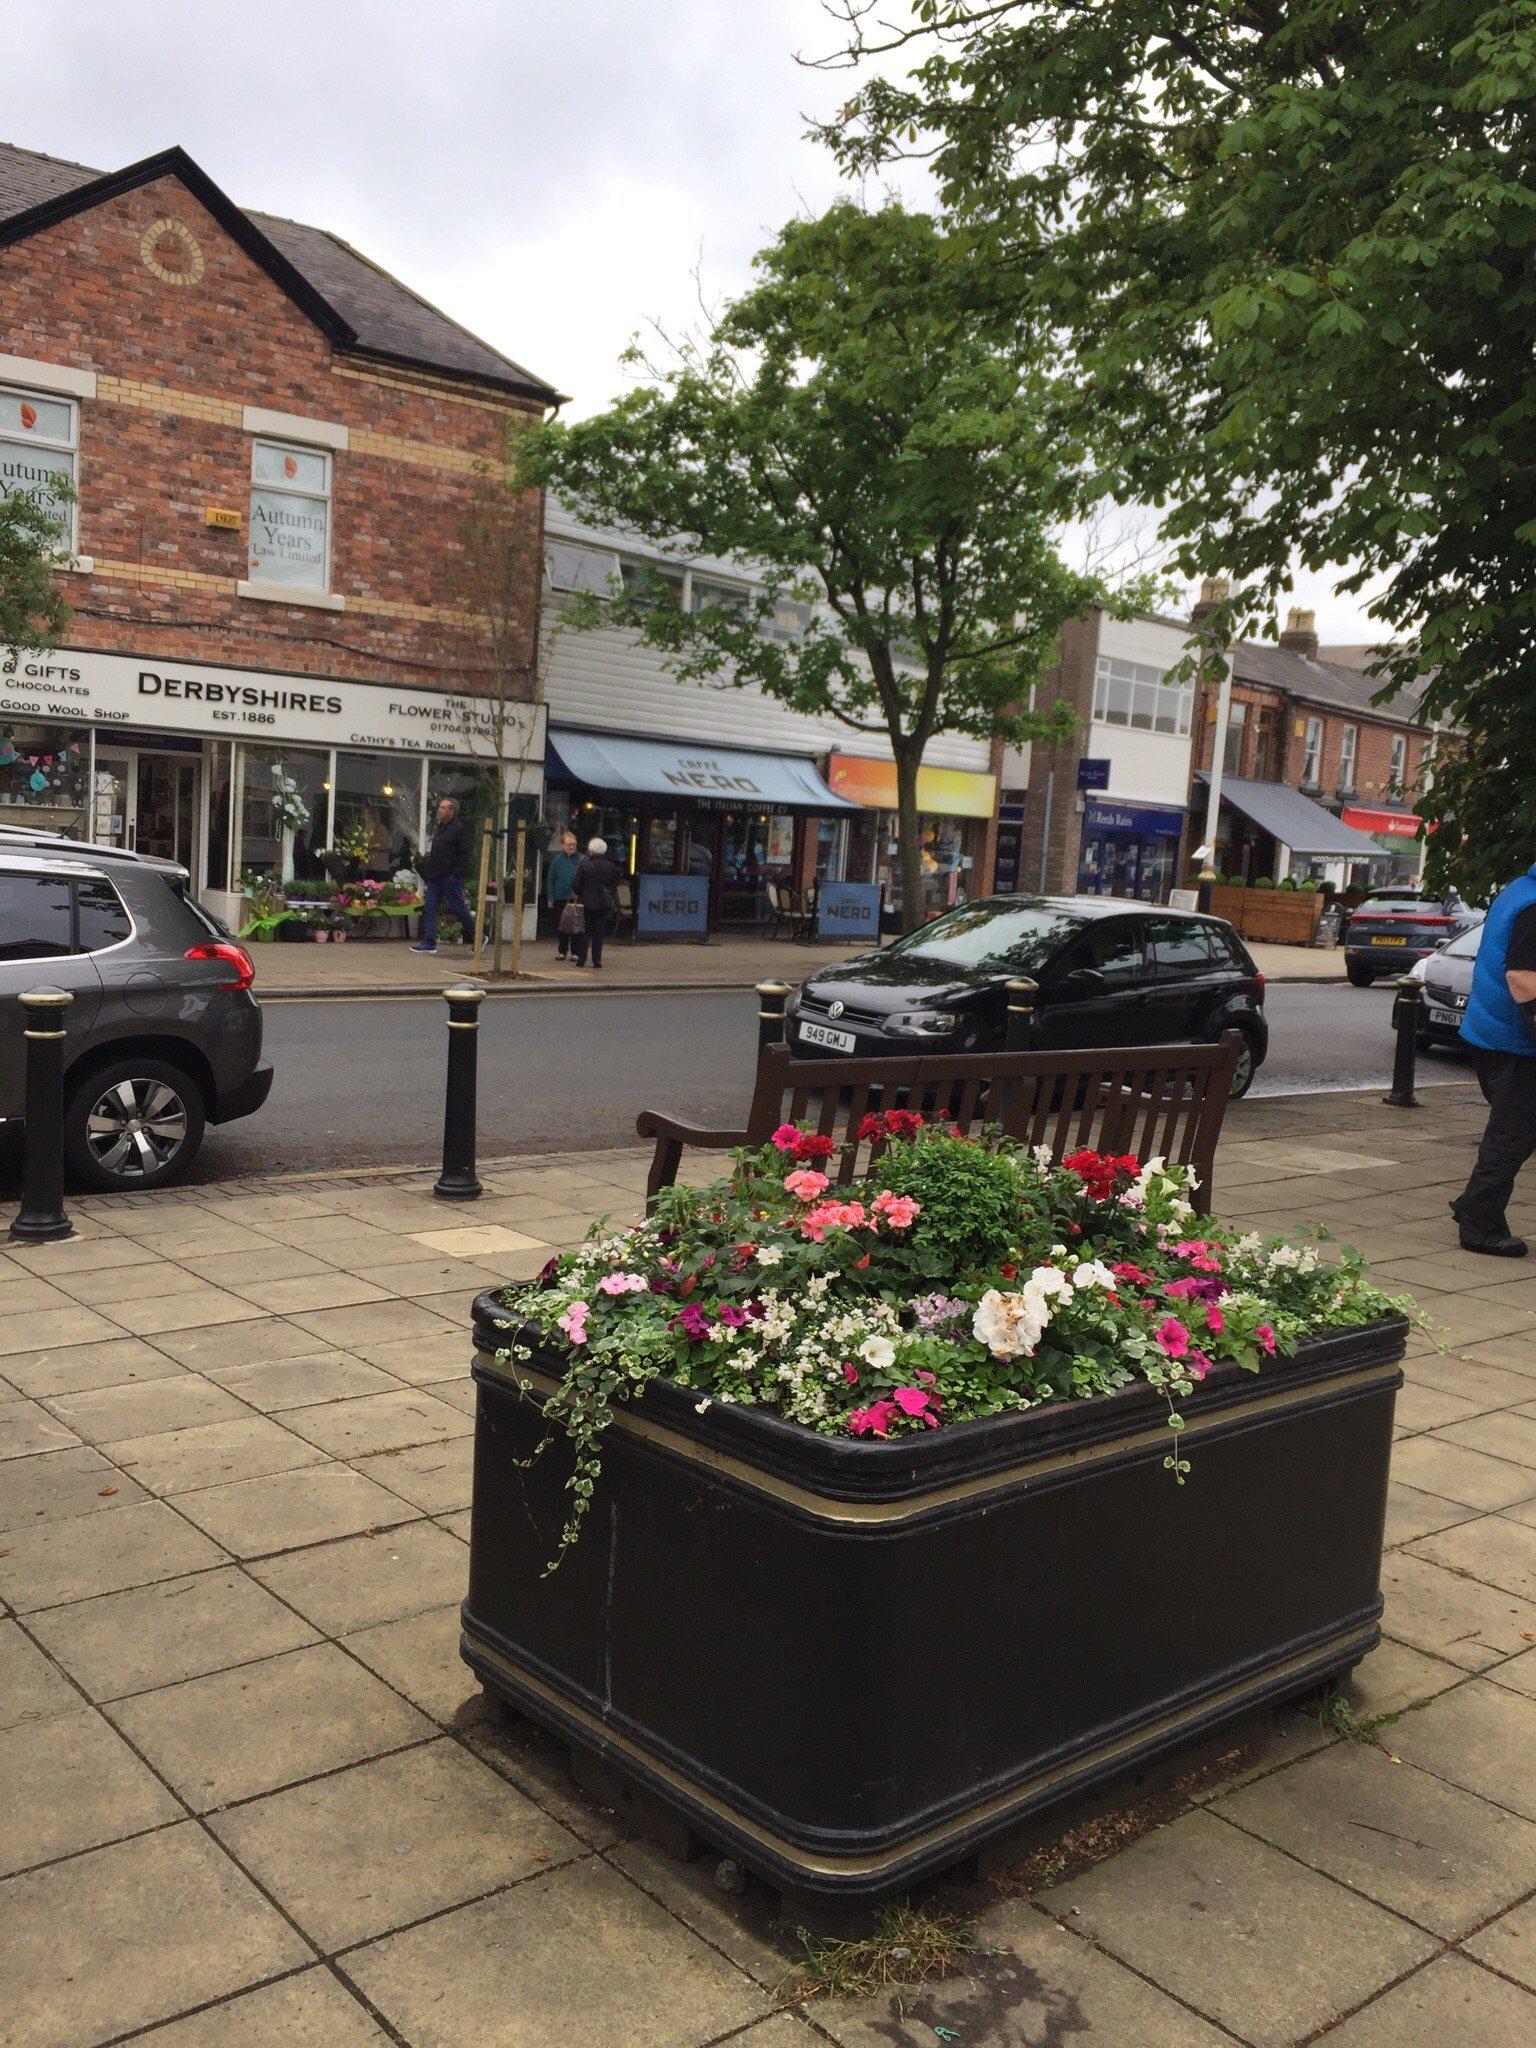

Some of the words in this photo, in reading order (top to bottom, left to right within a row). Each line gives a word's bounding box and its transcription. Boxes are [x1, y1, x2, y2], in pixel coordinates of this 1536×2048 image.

[252, 505, 325, 531] Autumn
[264, 526, 312, 550] Years
[253, 543, 276, 556] Law
[280, 549, 322, 564] Limited
[24, 664, 81, 680] GIFTS
[5, 679, 90, 696] CHOCOLATES
[138, 671, 343, 714] DERBYSHIRES
[1, 700, 41, 712] GOOD
[47, 703, 88, 716] WOOL
[94, 708, 130, 720] SHOP
[389, 703, 452, 720] FLOWER
[445, 699, 467, 709] THE
[350, 733, 396, 745] CATHY'S
[401, 738, 421, 749] TEA
[426, 740, 456, 750] ROOM
[661, 769, 762, 794] NERO
[648, 900, 700, 914] NERO
[827, 904, 872, 919] NERO
[806, 1026, 825, 1042] 949
